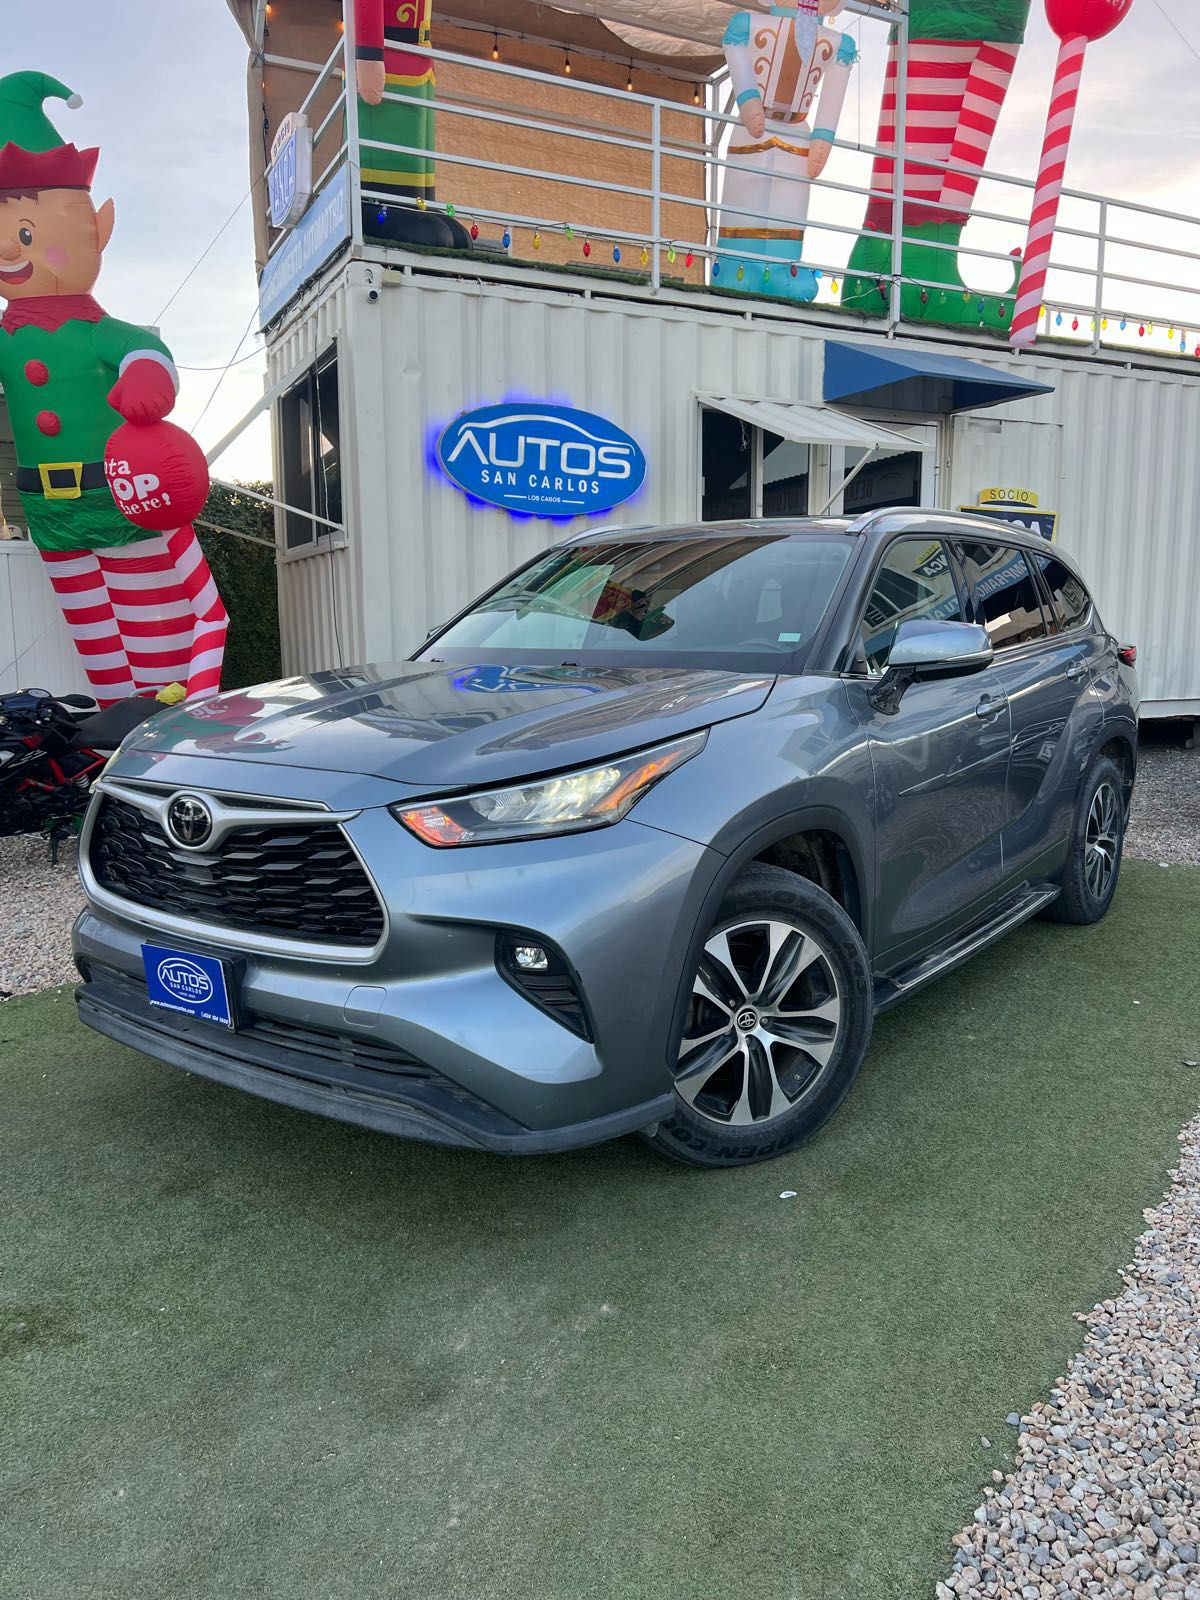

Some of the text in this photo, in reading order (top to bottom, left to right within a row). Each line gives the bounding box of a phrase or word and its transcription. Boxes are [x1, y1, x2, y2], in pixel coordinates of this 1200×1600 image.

[448, 430, 630, 479] AUTOS
[108, 474, 160, 501] OP
[481, 469, 600, 494] SAN CARLOS
[120, 492, 171, 515] here!
[989, 489, 1029, 502] SOCIO
[162, 968, 209, 990] AUTOS
